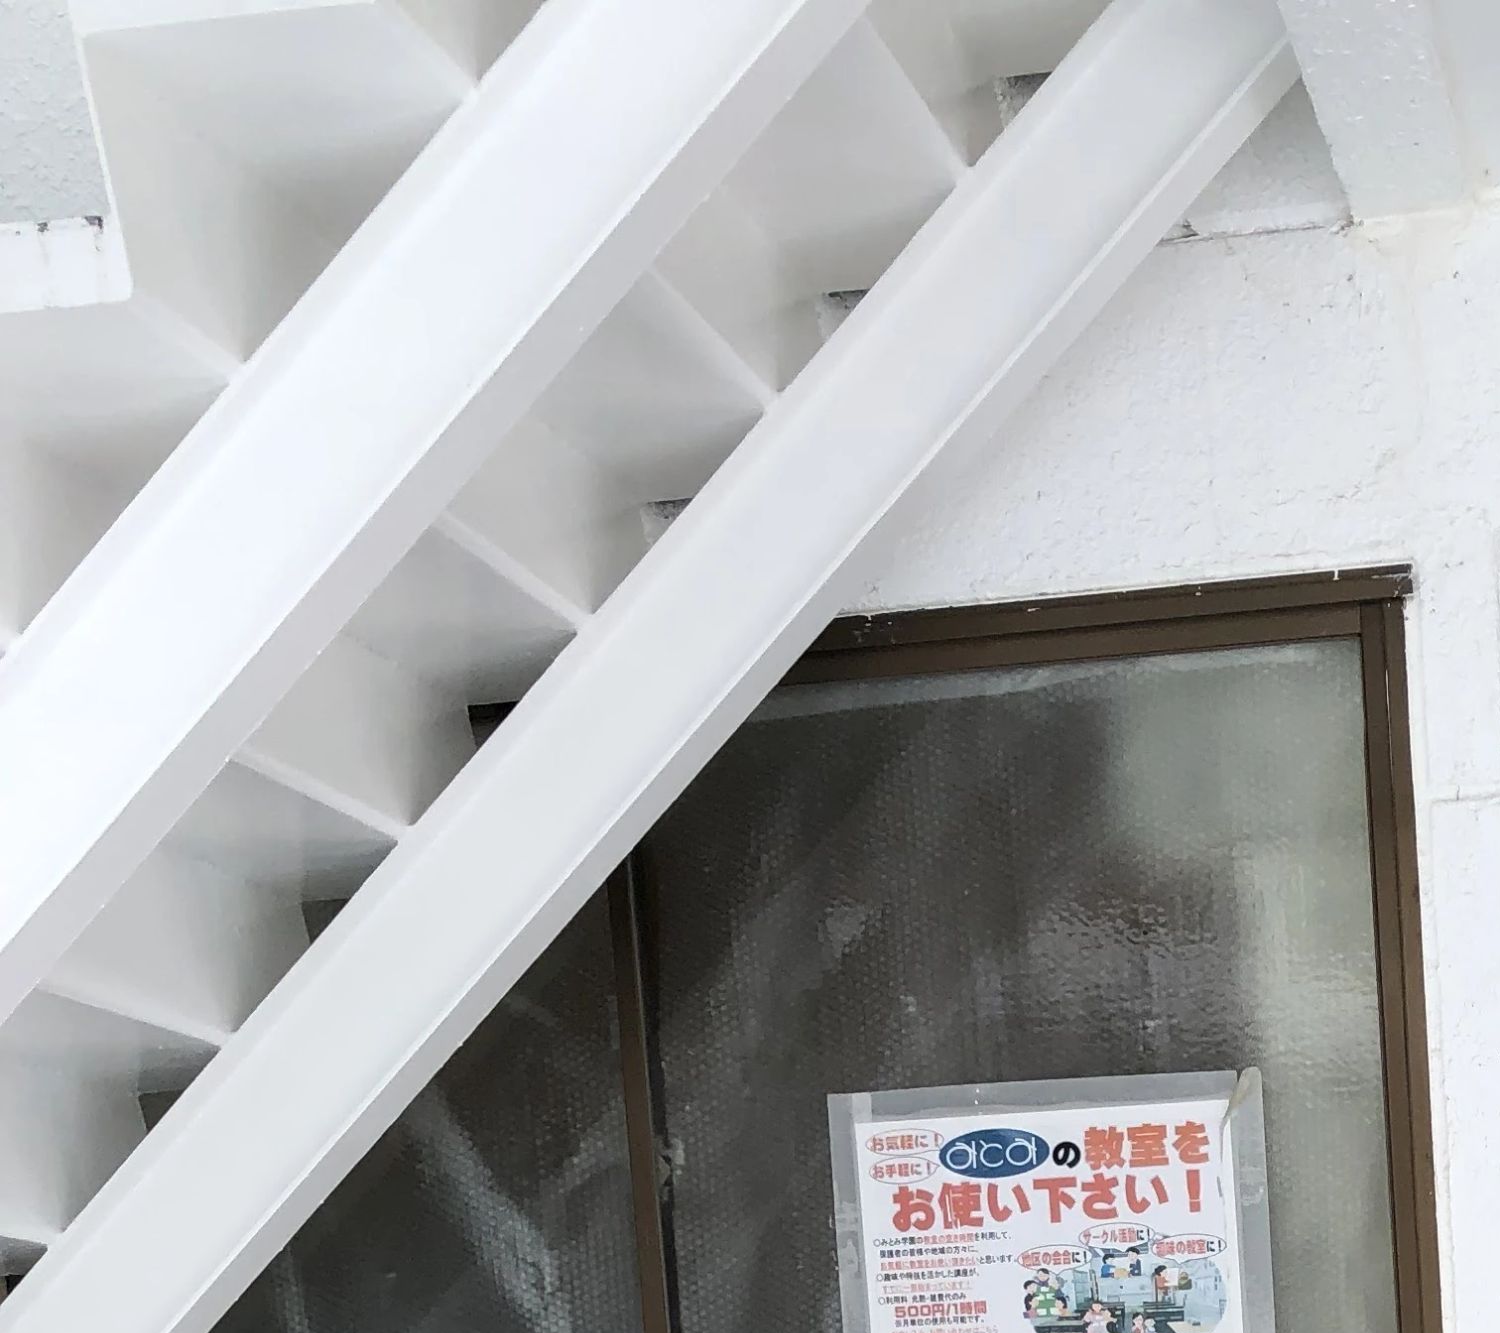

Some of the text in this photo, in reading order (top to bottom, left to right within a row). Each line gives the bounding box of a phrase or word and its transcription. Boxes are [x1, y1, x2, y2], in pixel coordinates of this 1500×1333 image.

[892, 1169, 1201, 1232] お使い下さい！
